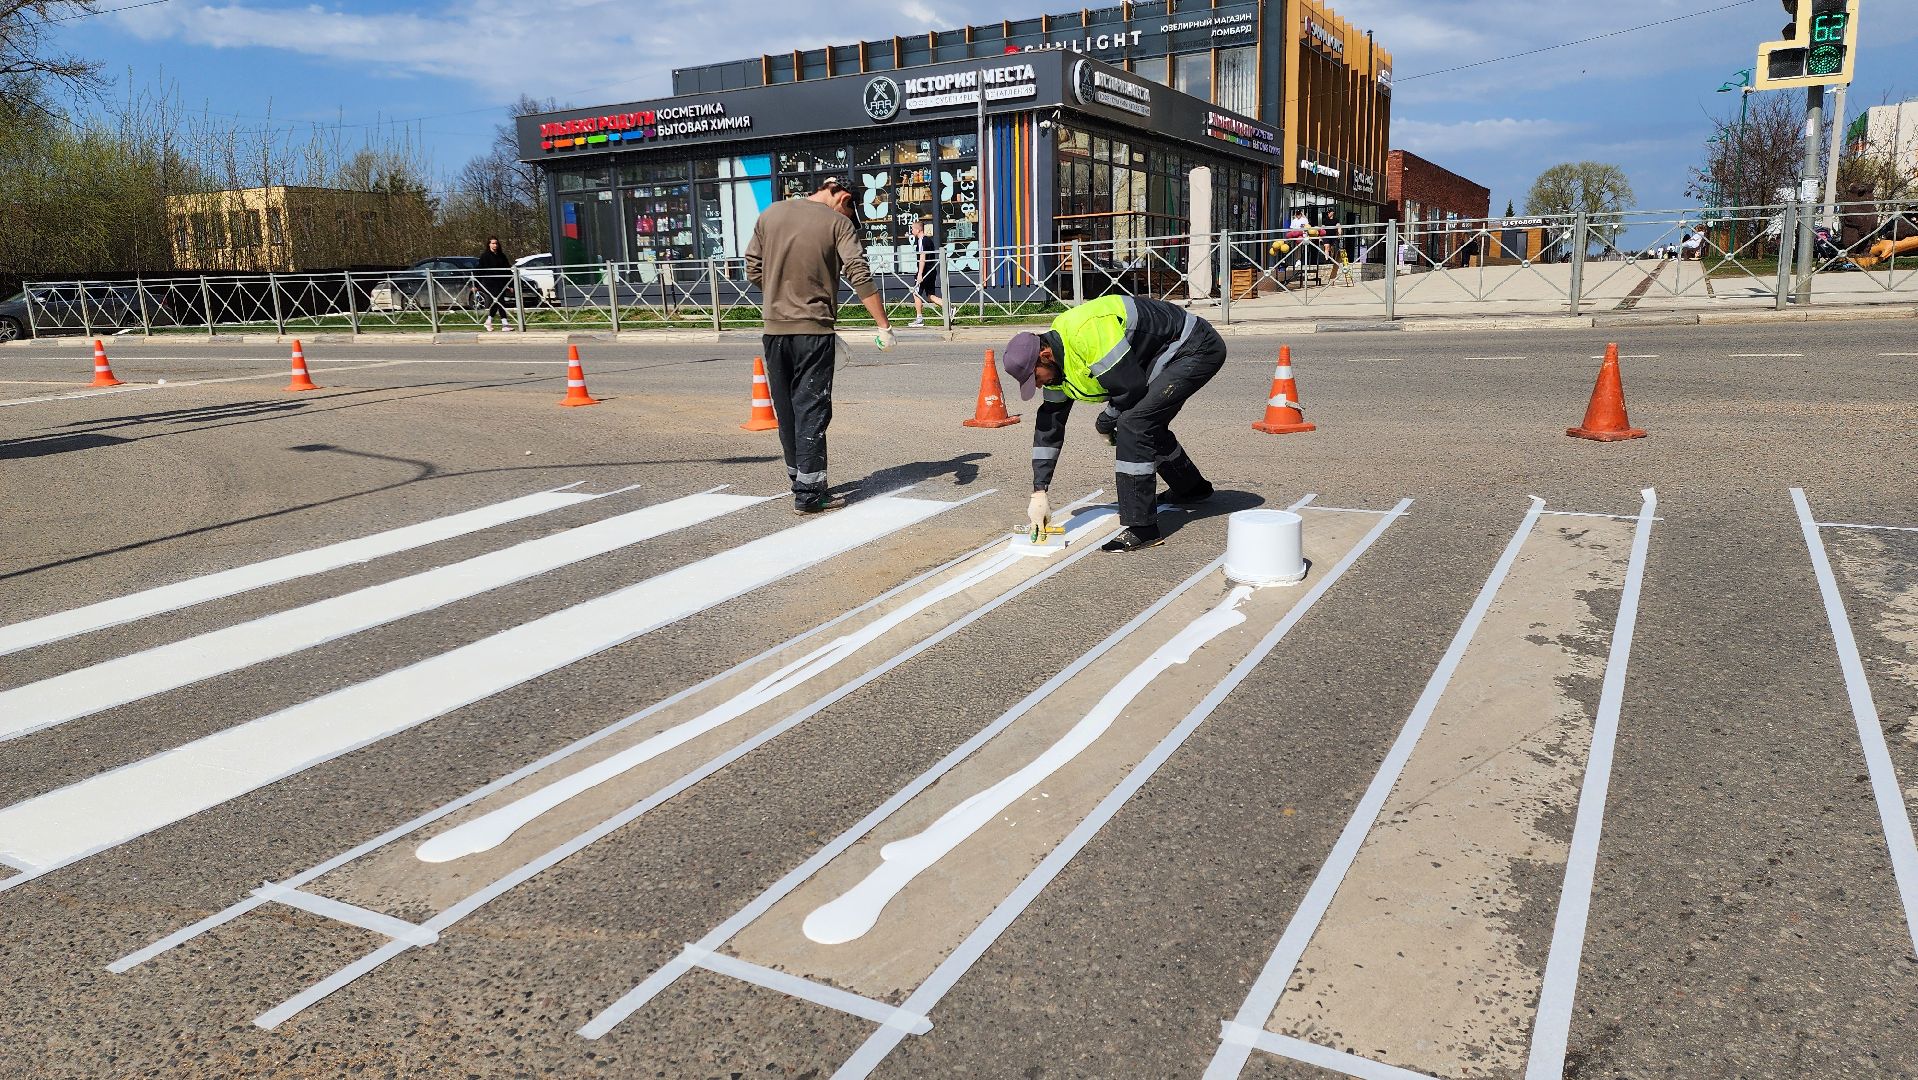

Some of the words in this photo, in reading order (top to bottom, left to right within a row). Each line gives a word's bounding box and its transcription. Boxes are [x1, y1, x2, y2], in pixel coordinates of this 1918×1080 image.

[1160, 18, 1213, 33] ЮВЕЛИРНЫЙ
[1214, 12, 1252, 25] МАГАЗИН
[1210, 24, 1252, 37] ЛОМБАРД
[1815, 14, 1844, 41] 62
[905, 71, 978, 94] ИСТОРИЯ
[982, 63, 1036, 84] МЕСТА
[656, 102, 724, 121] КОСМЕТИКА
[657, 120, 709, 137] БЫТОВАЯ
[710, 115, 751, 131] ХИМИЯ
[960, 171, 976, 214] 1328
